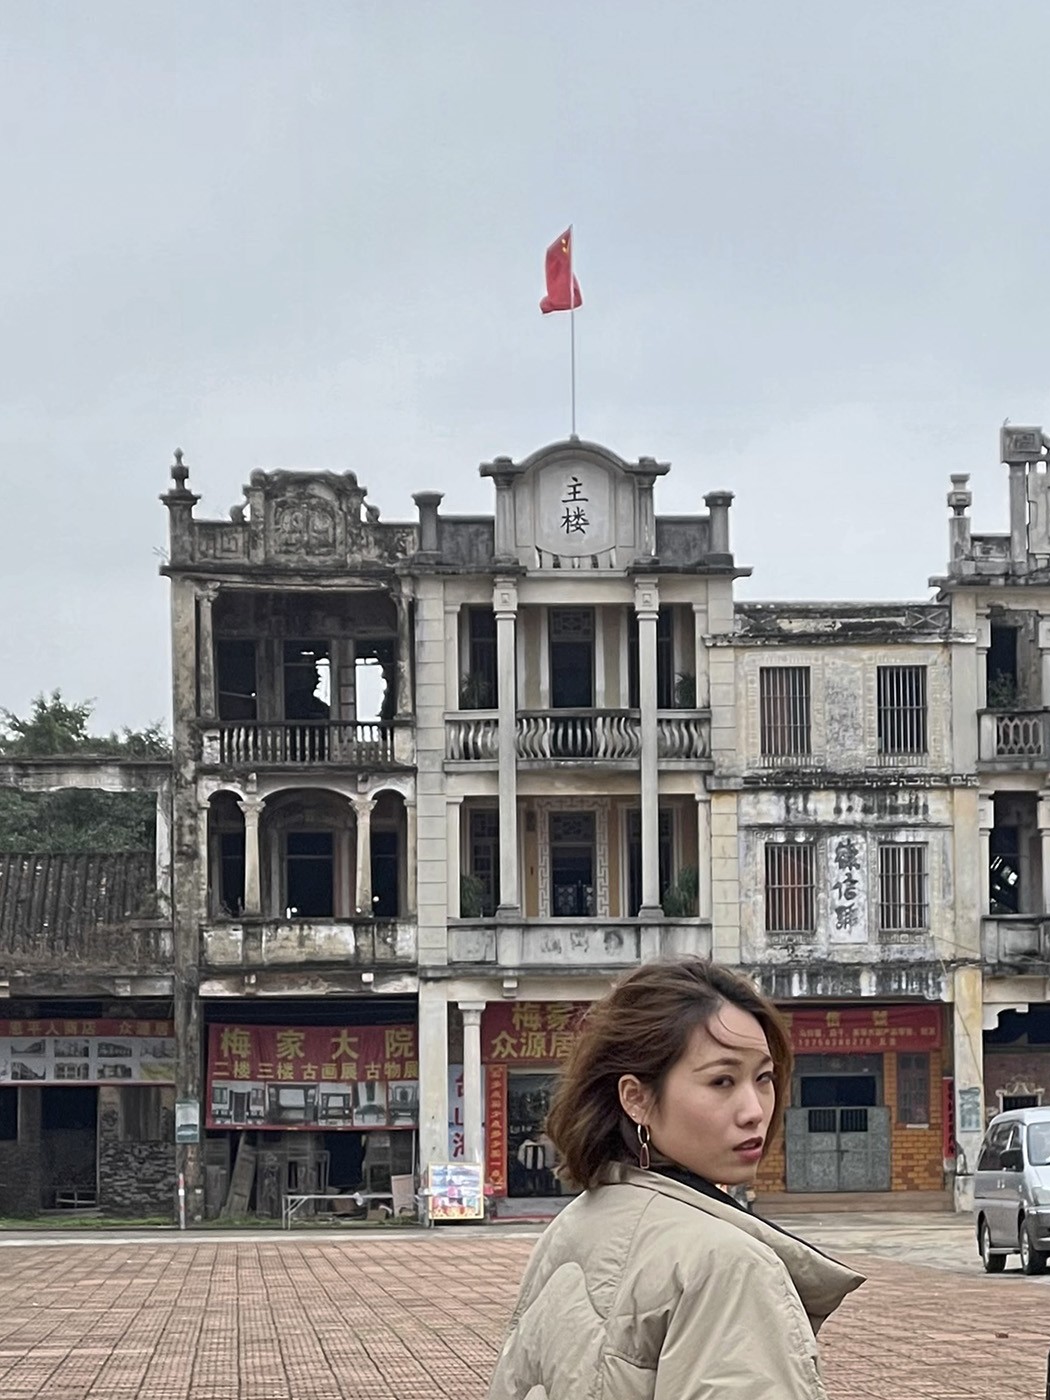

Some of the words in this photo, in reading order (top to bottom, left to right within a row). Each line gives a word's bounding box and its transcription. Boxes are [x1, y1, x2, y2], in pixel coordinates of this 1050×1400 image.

[560, 476, 590, 534] 主楼
[220, 1027, 415, 1060] 梅家大院
